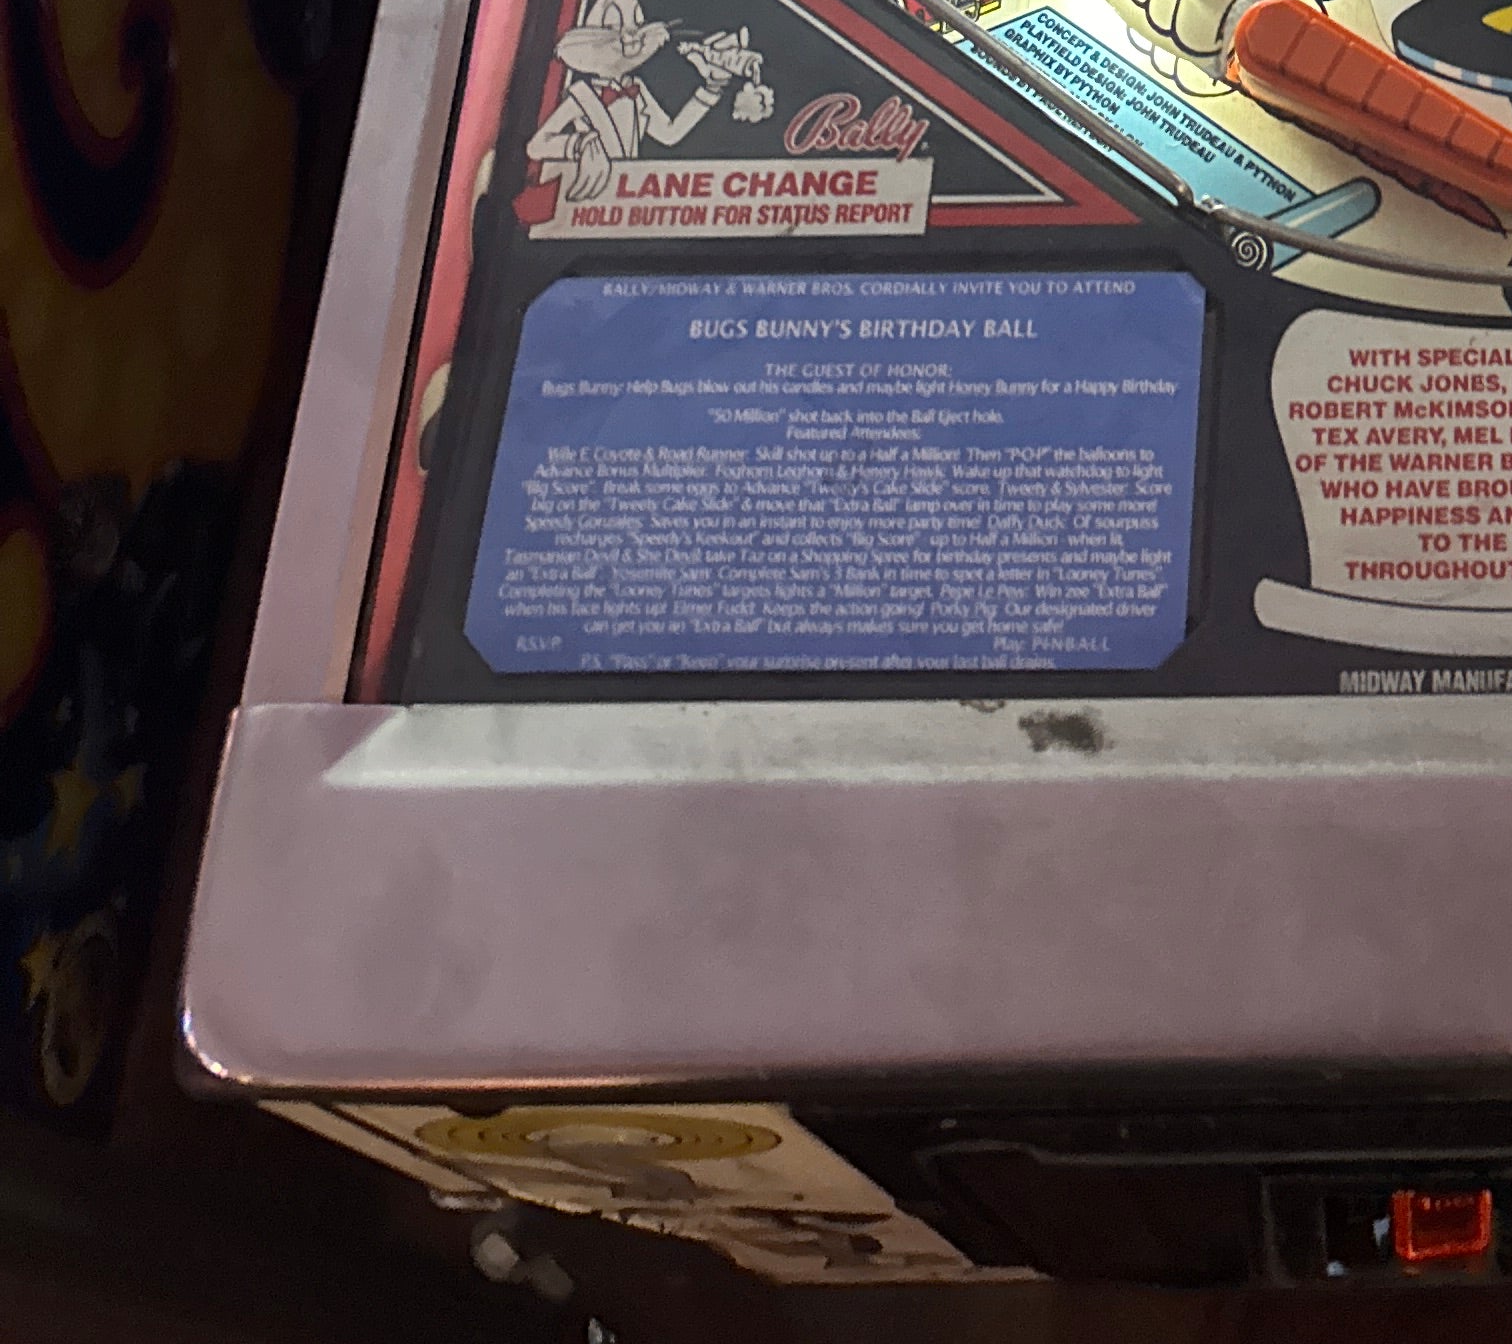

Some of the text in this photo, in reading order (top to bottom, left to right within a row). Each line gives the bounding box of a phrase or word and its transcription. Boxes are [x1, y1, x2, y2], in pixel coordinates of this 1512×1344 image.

[1003, 27, 1122, 116] GRAPHIX BY PYTHON
[1020, 19, 1082, 68] PLAYFIELD
[1125, 95, 1162, 124] JOHN
[1158, 117, 1218, 165] TRUDEAU
[1036, 12, 1299, 204] CONCEPT & DESIGN: JOHN TRUDEAU & PYTHON
[784, 93, 931, 163] Bally
[616, 170, 879, 199] LANE CHANGE
[571, 202, 914, 227] HOLD BUTTON FOR STATUS REPORT
[602, 281, 721, 297] BALLY/MIDWAY
[742, 282, 807, 297] WARNER
[860, 281, 948, 297] CORDIALLY
[952, 281, 1003, 296] INVITE
[1008, 281, 1041, 296] YOU
[1046, 281, 1069, 296] TO
[1072, 281, 1137, 296] ATTEND
[688, 318, 1039, 339] BUGS BUNNY'S BIRTHDAY BALL
[1348, 349, 1412, 368] WITH
[765, 363, 953, 379] THE GUEST OF HONOR:
[1327, 374, 1414, 393] CHUCK
[1420, 373, 1507, 397] JONES,
[1288, 401, 1387, 421] ROBERT
[1312, 427, 1359, 446] TEX
[1365, 426, 1448, 449] AVERY,
[1453, 426, 1504, 445] MEL
[1295, 454, 1327, 473] OF
[1333, 453, 1382, 472] THE
[1388, 452, 1495, 472] WARNER
[1320, 480, 1379, 499] WHO
[1385, 479, 1451, 499] HAVE
[1340, 506, 1481, 526] HAPPINESS
[1417, 534, 1452, 553] TO
[1456, 533, 1508, 552] THE
[1340, 670, 1425, 693] MIDWAY
